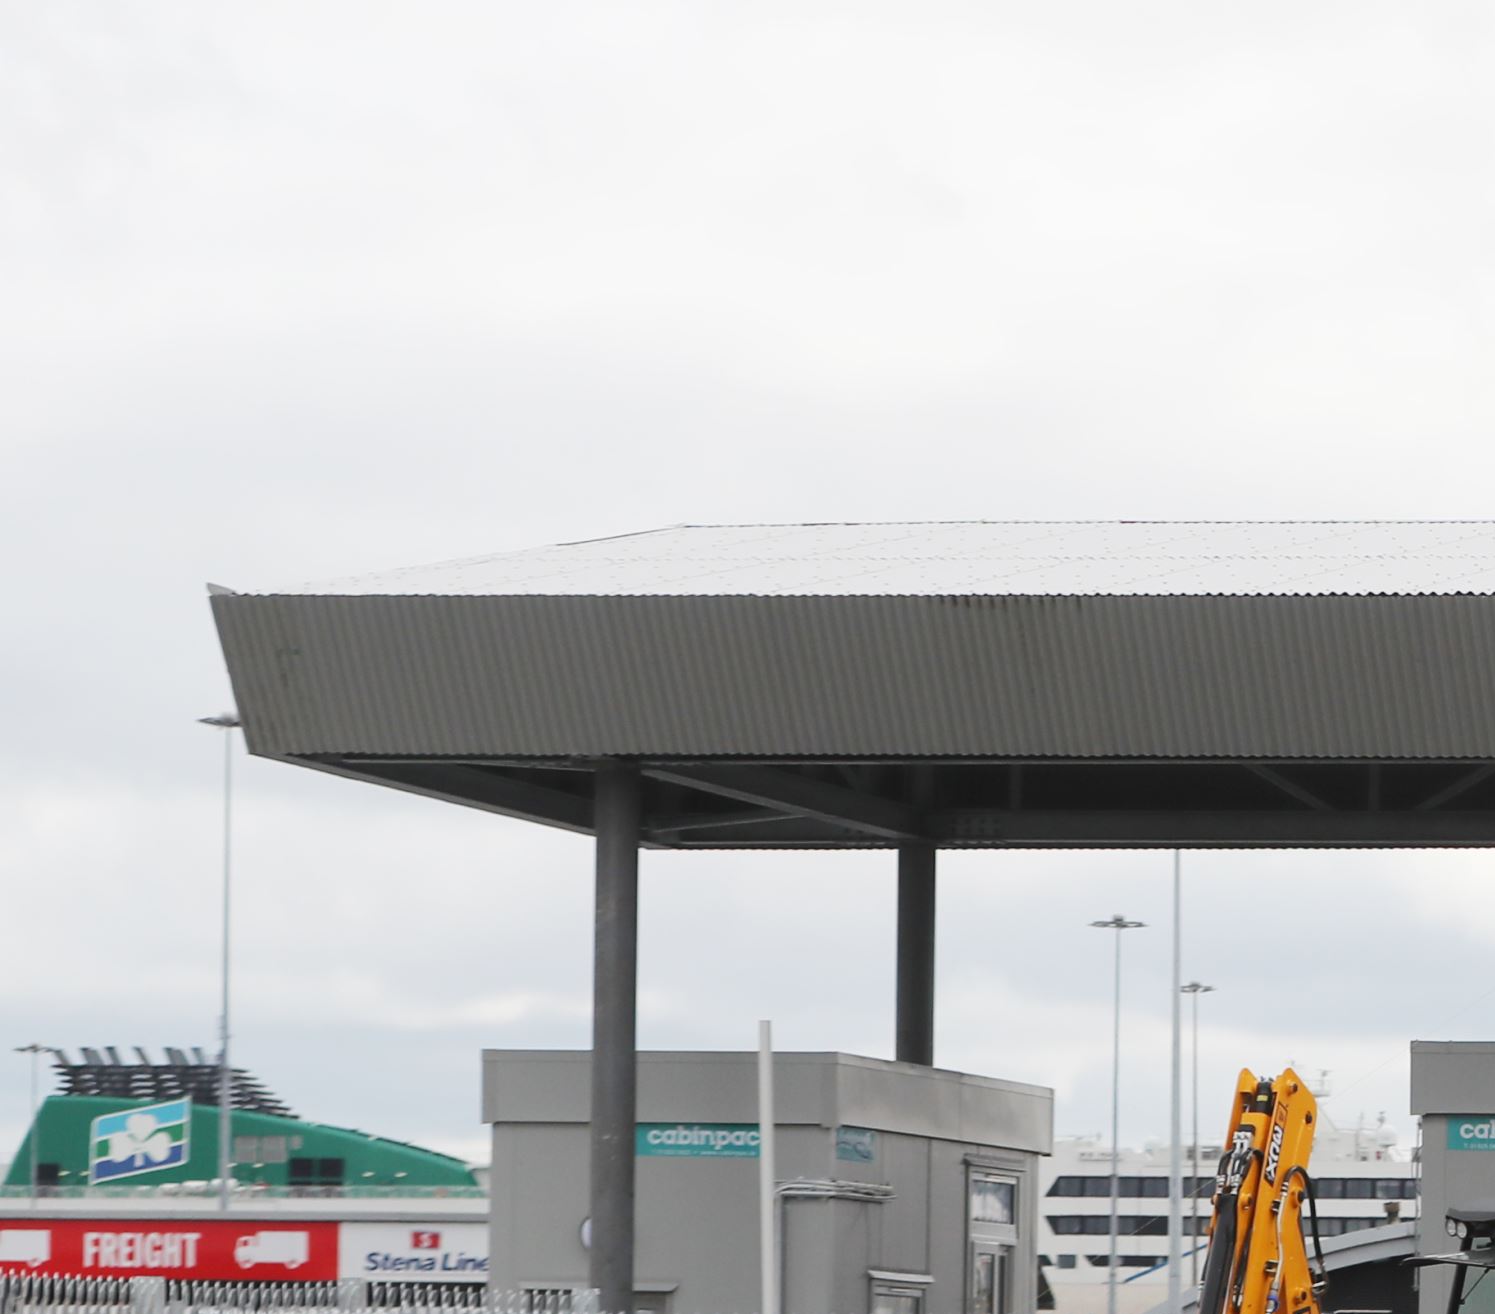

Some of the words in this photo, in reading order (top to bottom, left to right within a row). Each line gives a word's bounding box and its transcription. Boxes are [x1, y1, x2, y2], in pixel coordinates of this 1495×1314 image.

[647, 1125, 760, 1150] cabinpac
[83, 1231, 202, 1268] FREIGHT
[366, 1252, 436, 1271] Stena
[441, 1252, 490, 1272] Line
